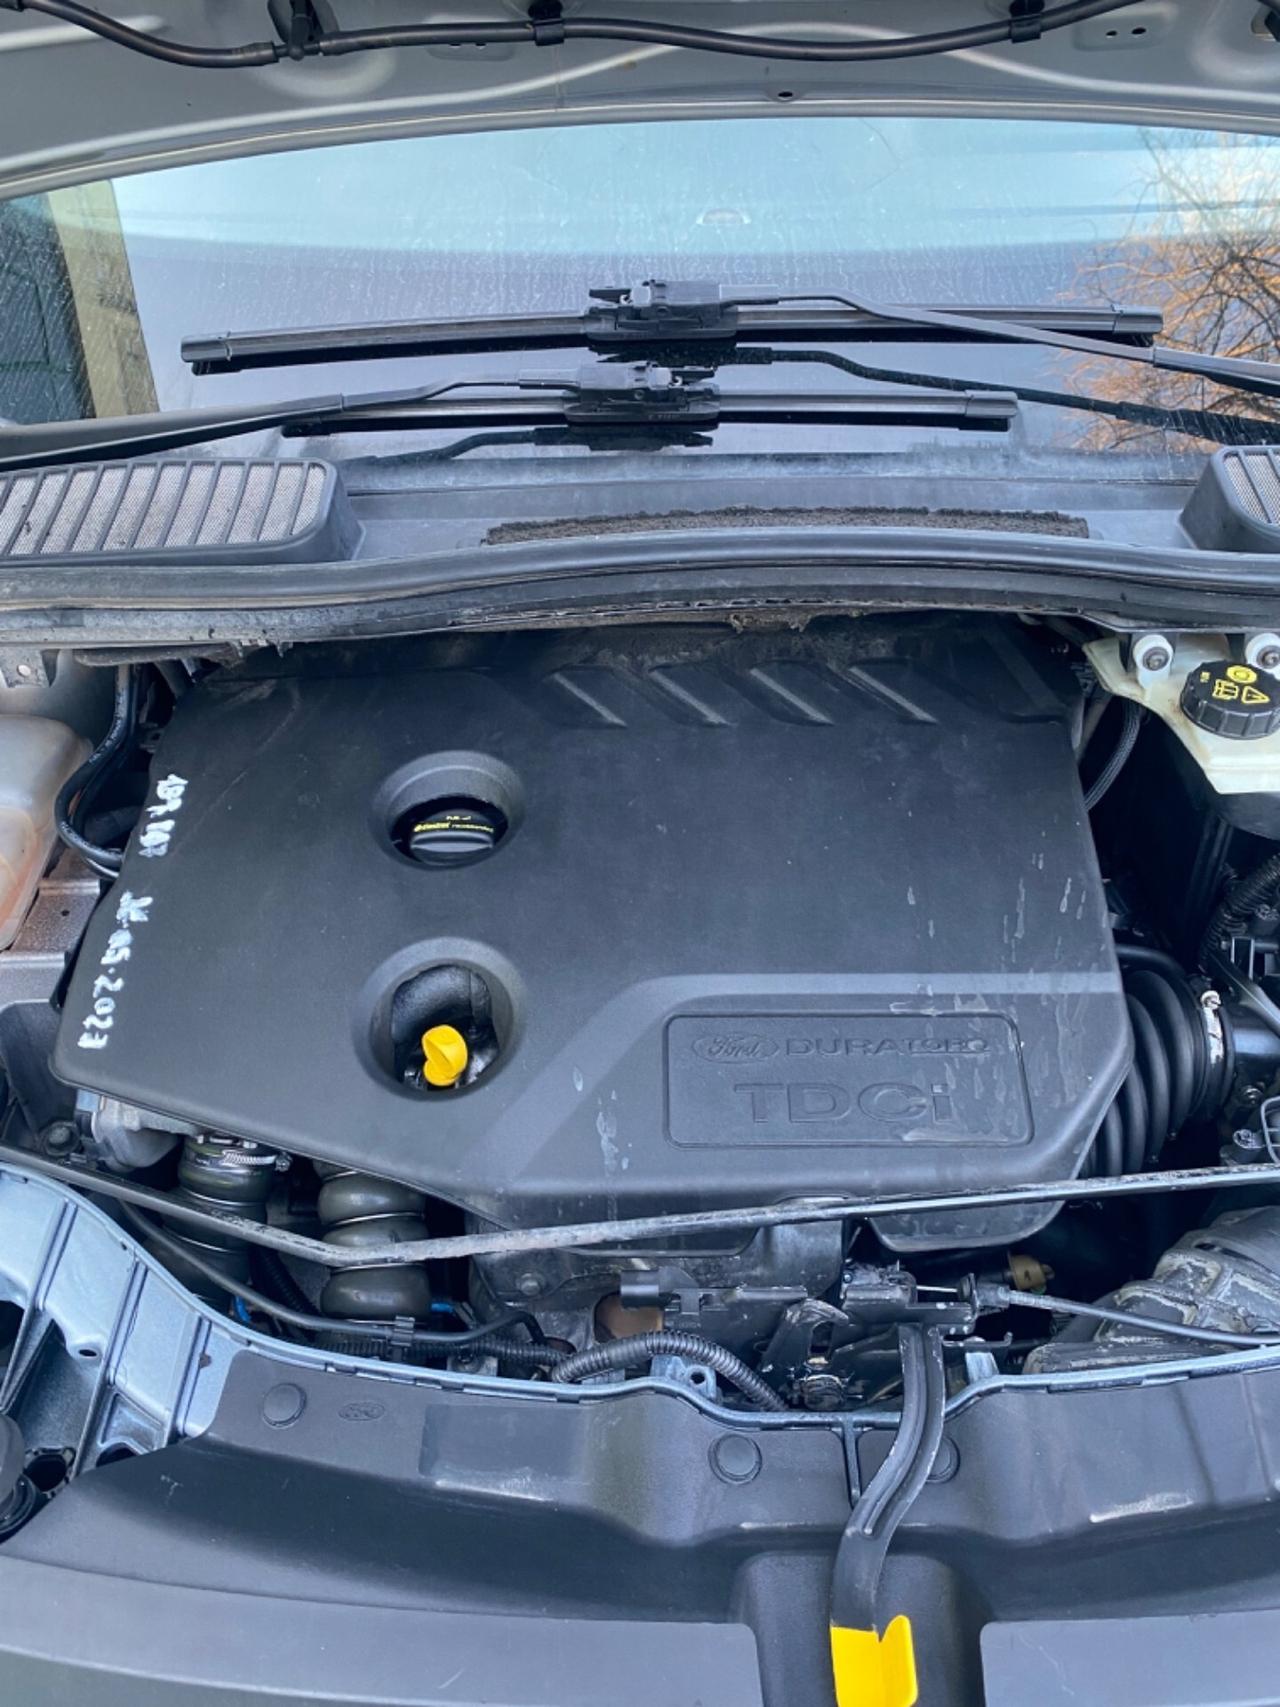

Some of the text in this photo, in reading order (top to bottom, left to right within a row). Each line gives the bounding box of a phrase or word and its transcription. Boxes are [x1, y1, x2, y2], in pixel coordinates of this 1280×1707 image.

[706, 1034, 991, 1058] Ford DURATORQ
[733, 1082, 953, 1124] TDCi
